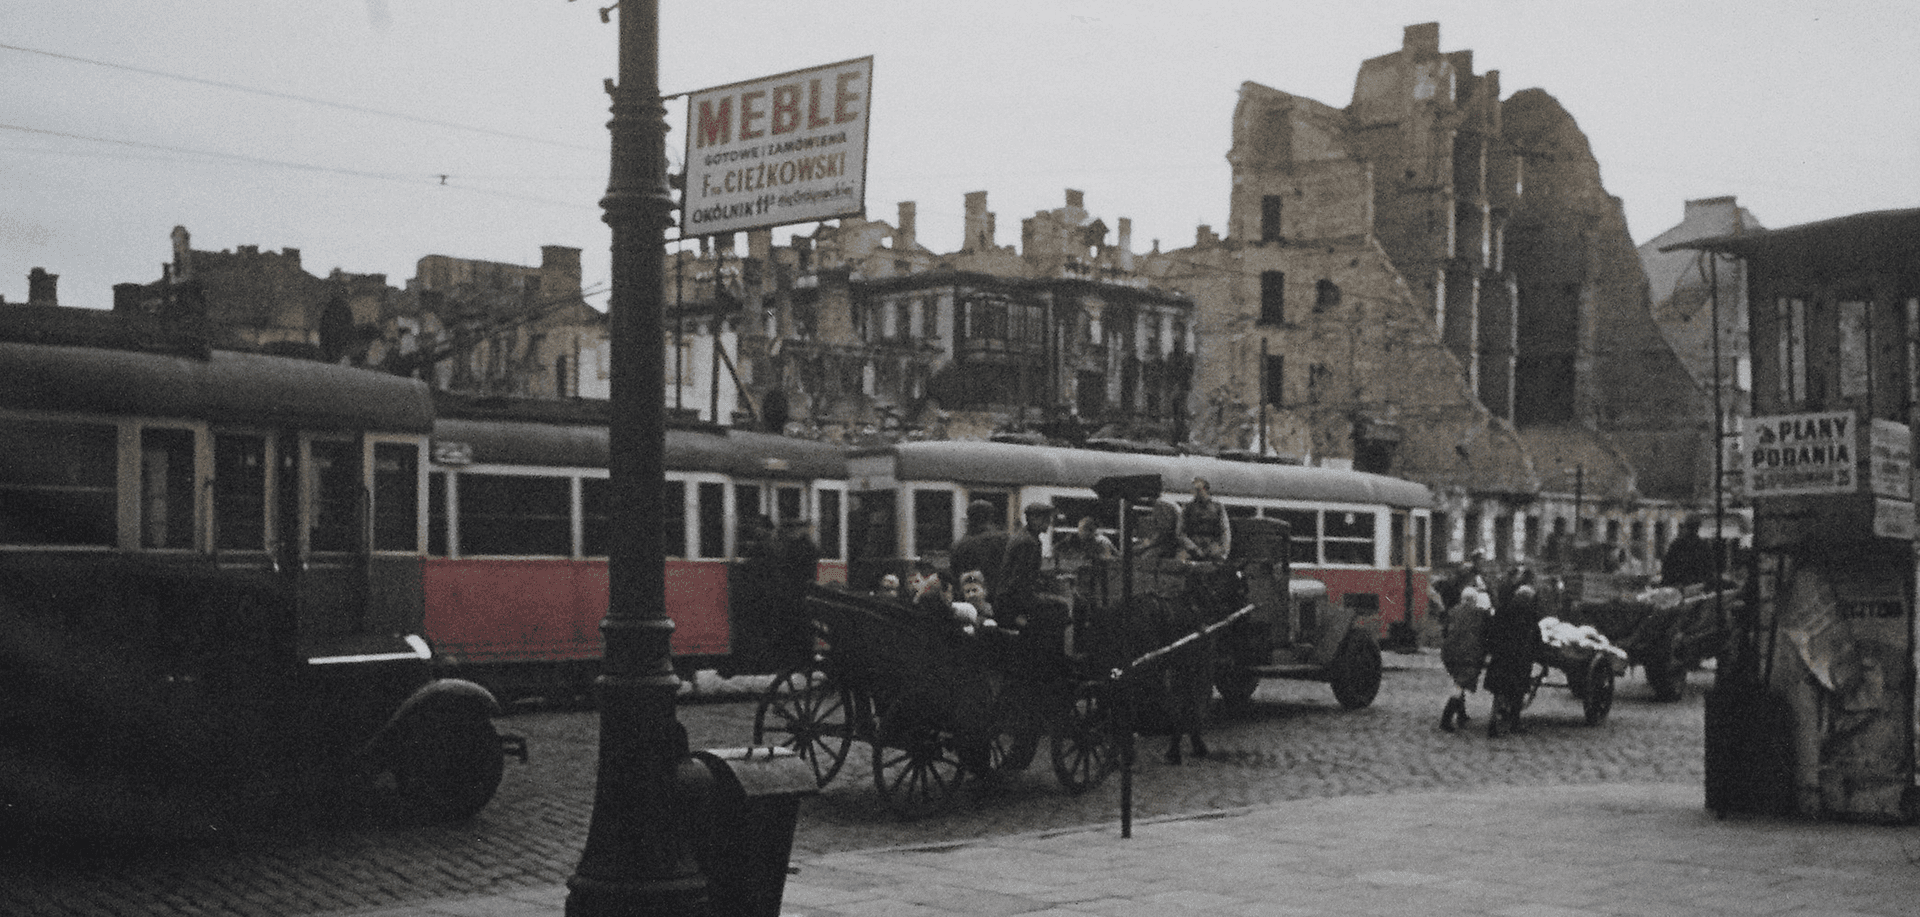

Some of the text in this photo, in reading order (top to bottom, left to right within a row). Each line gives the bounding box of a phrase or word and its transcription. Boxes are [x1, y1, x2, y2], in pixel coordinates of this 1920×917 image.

[697, 71, 863, 149] MEBLE
[705, 147, 757, 166] GOTOWE
[768, 131, 847, 157] ZAMÓWIENIA
[724, 151, 846, 194] CIĘŻKOWSKI
[692, 200, 753, 224] OKÓLNIK
[1779, 416, 1848, 442] PLANY
[1752, 444, 1849, 469] PODANIA
